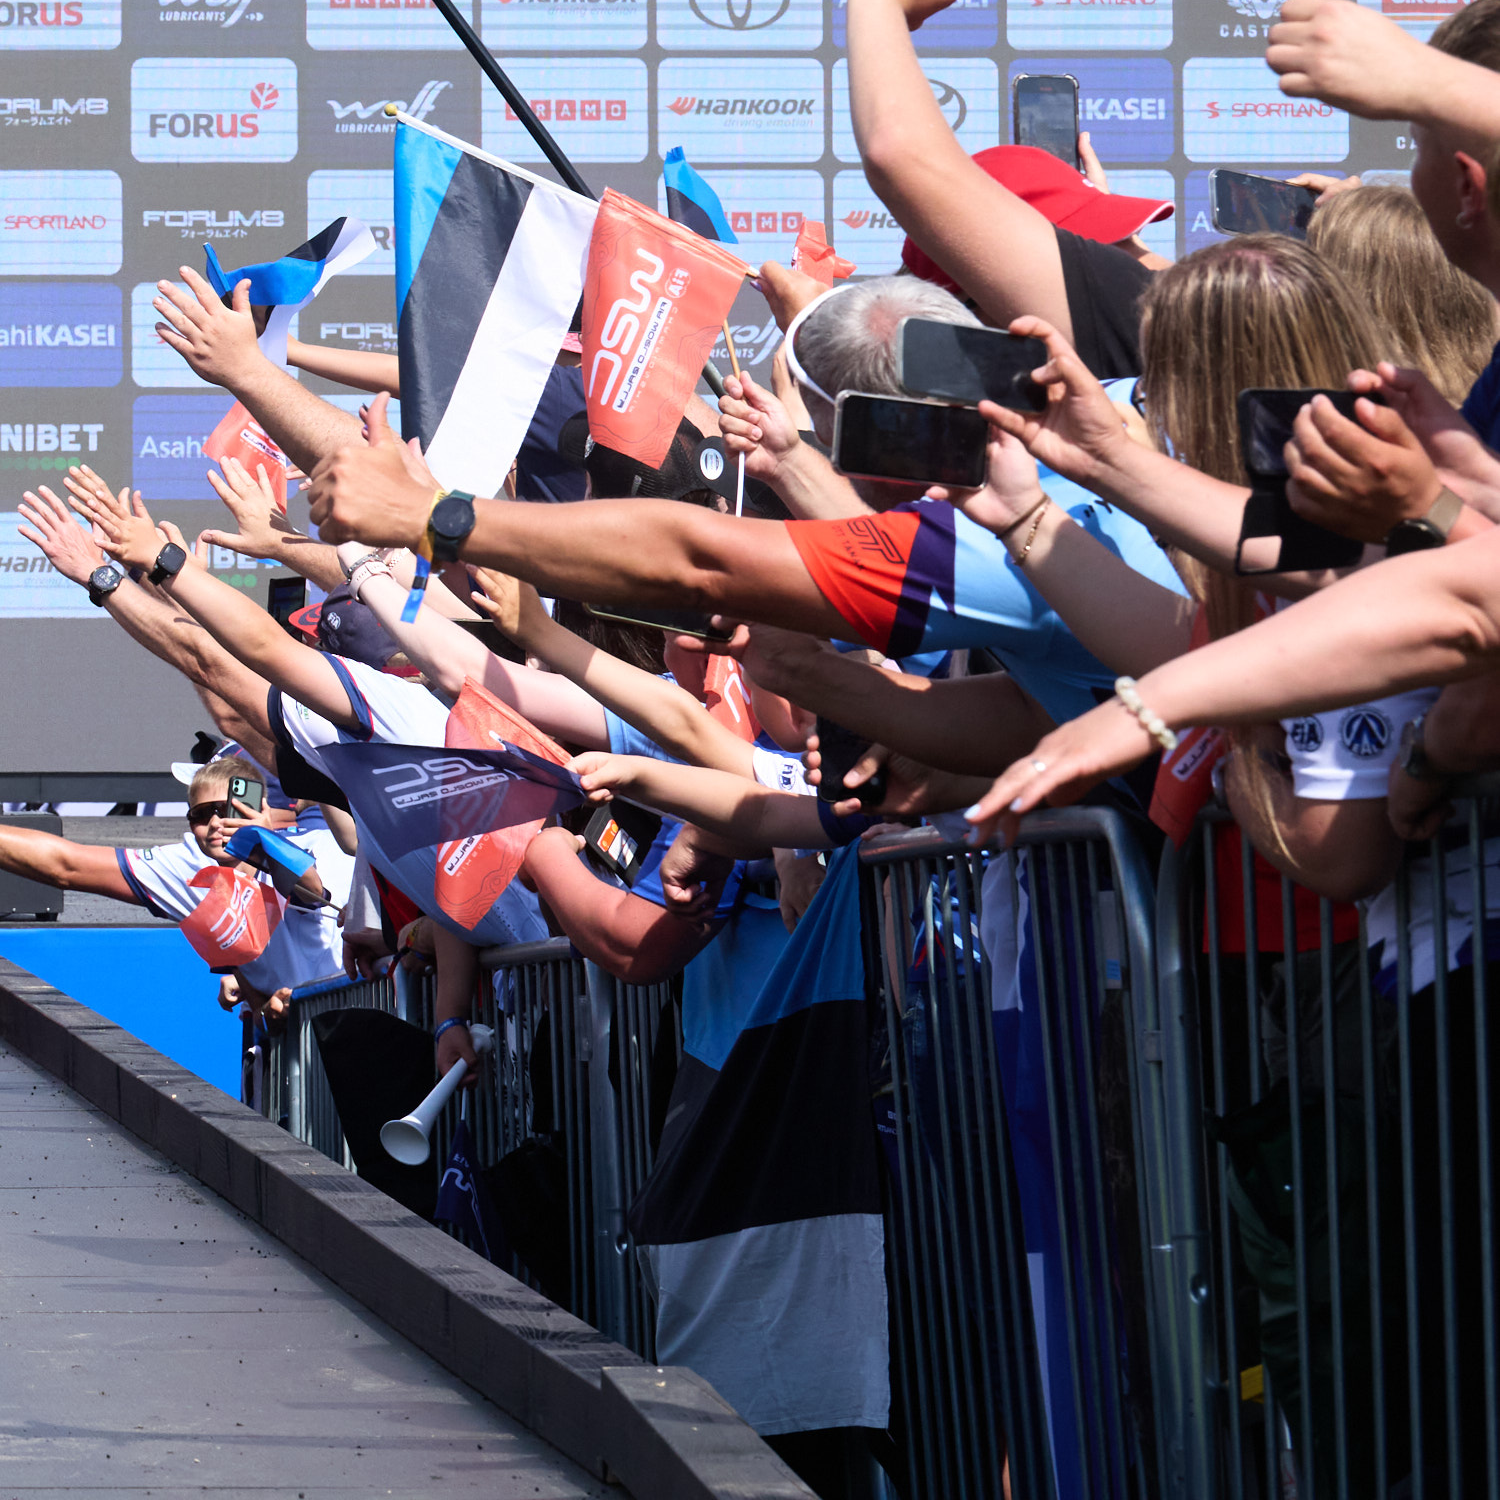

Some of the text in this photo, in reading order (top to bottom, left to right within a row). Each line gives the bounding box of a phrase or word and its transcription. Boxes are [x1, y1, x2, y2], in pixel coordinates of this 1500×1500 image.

[160, 12, 227, 22] LUBRICANTS
[1231, 102, 1333, 118] SPORTLAND
[149, 112, 260, 138] FORUS
[4, 215, 106, 231] SPORTLAND
[143, 209, 286, 227] FORUM8
